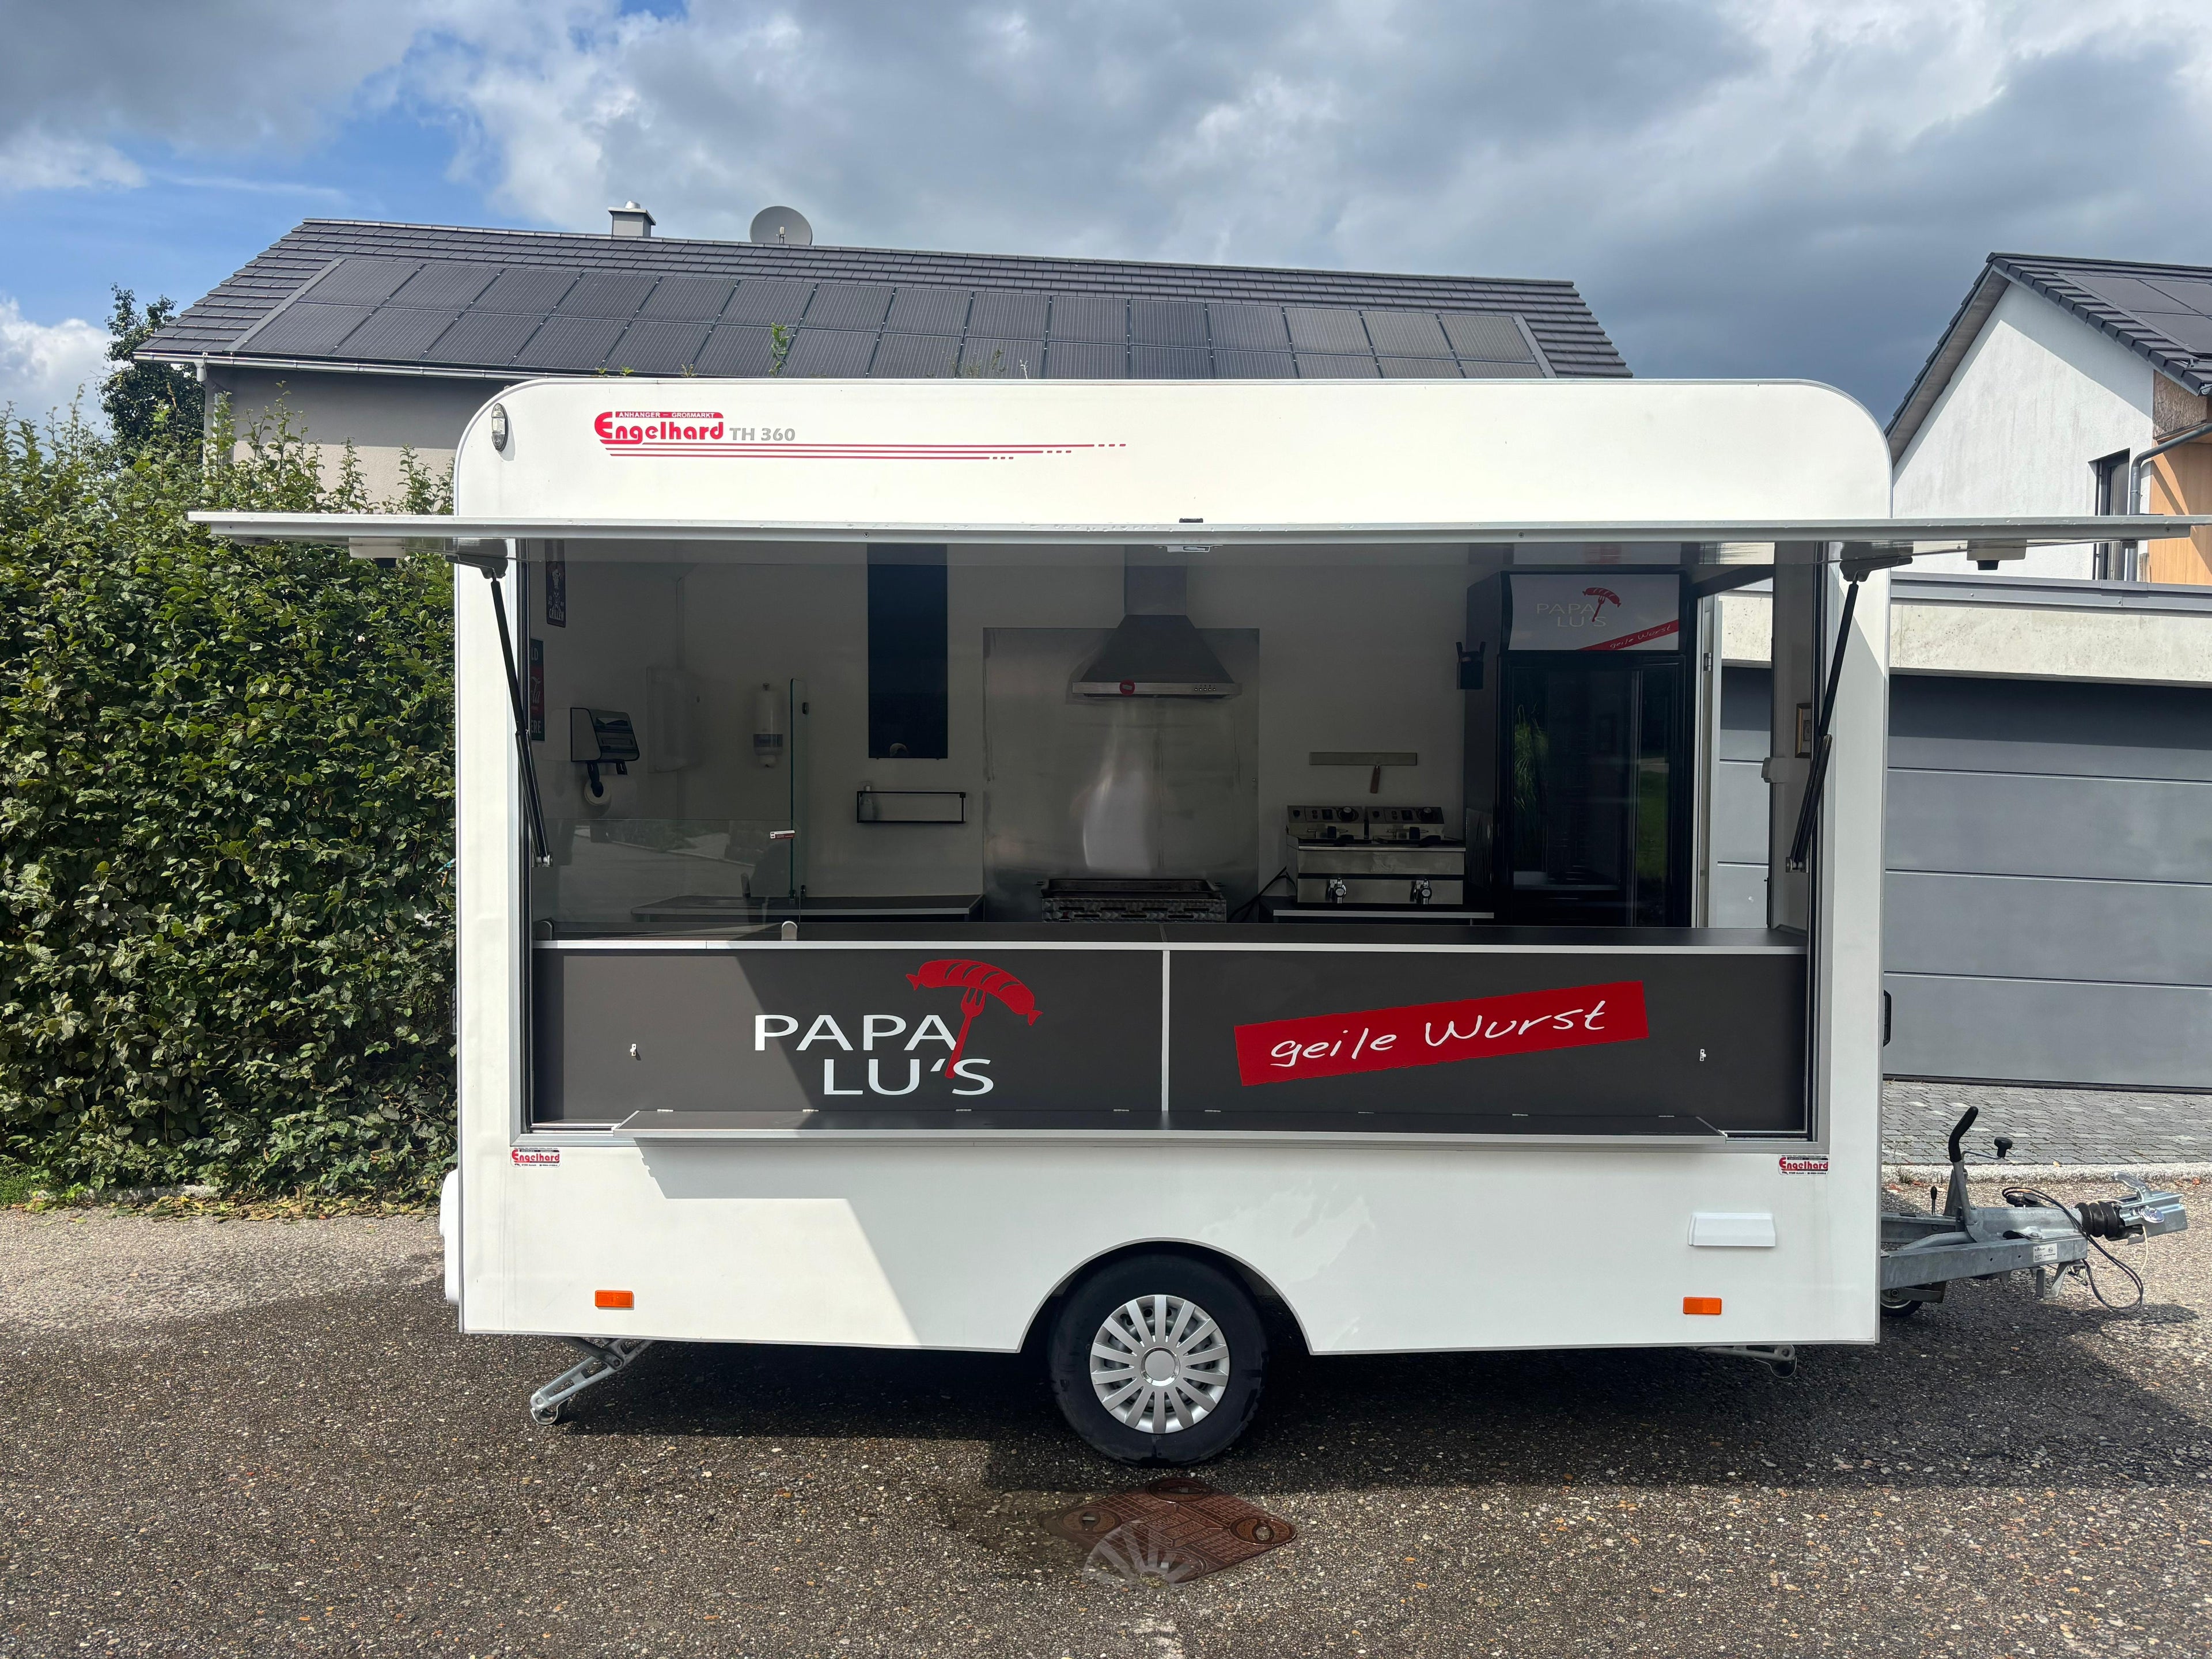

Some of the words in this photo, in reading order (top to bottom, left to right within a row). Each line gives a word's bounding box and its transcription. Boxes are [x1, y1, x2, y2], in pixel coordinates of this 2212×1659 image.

[594, 411, 724, 444] Engelhard
[730, 428, 755, 440] TH
[761, 428, 796, 441] 360
[1536, 603, 1595, 615] PAPA
[1609, 638, 1633, 649] geile
[1638, 624, 1671, 640] Wurst
[755, 1014, 957, 1051] PAPA
[1270, 1028, 1397, 1067] geile
[1425, 1000, 1606, 1047] Wurst
[512, 1149, 559, 1162] Engelhard
[1779, 1157, 1828, 1171] Engelhard
